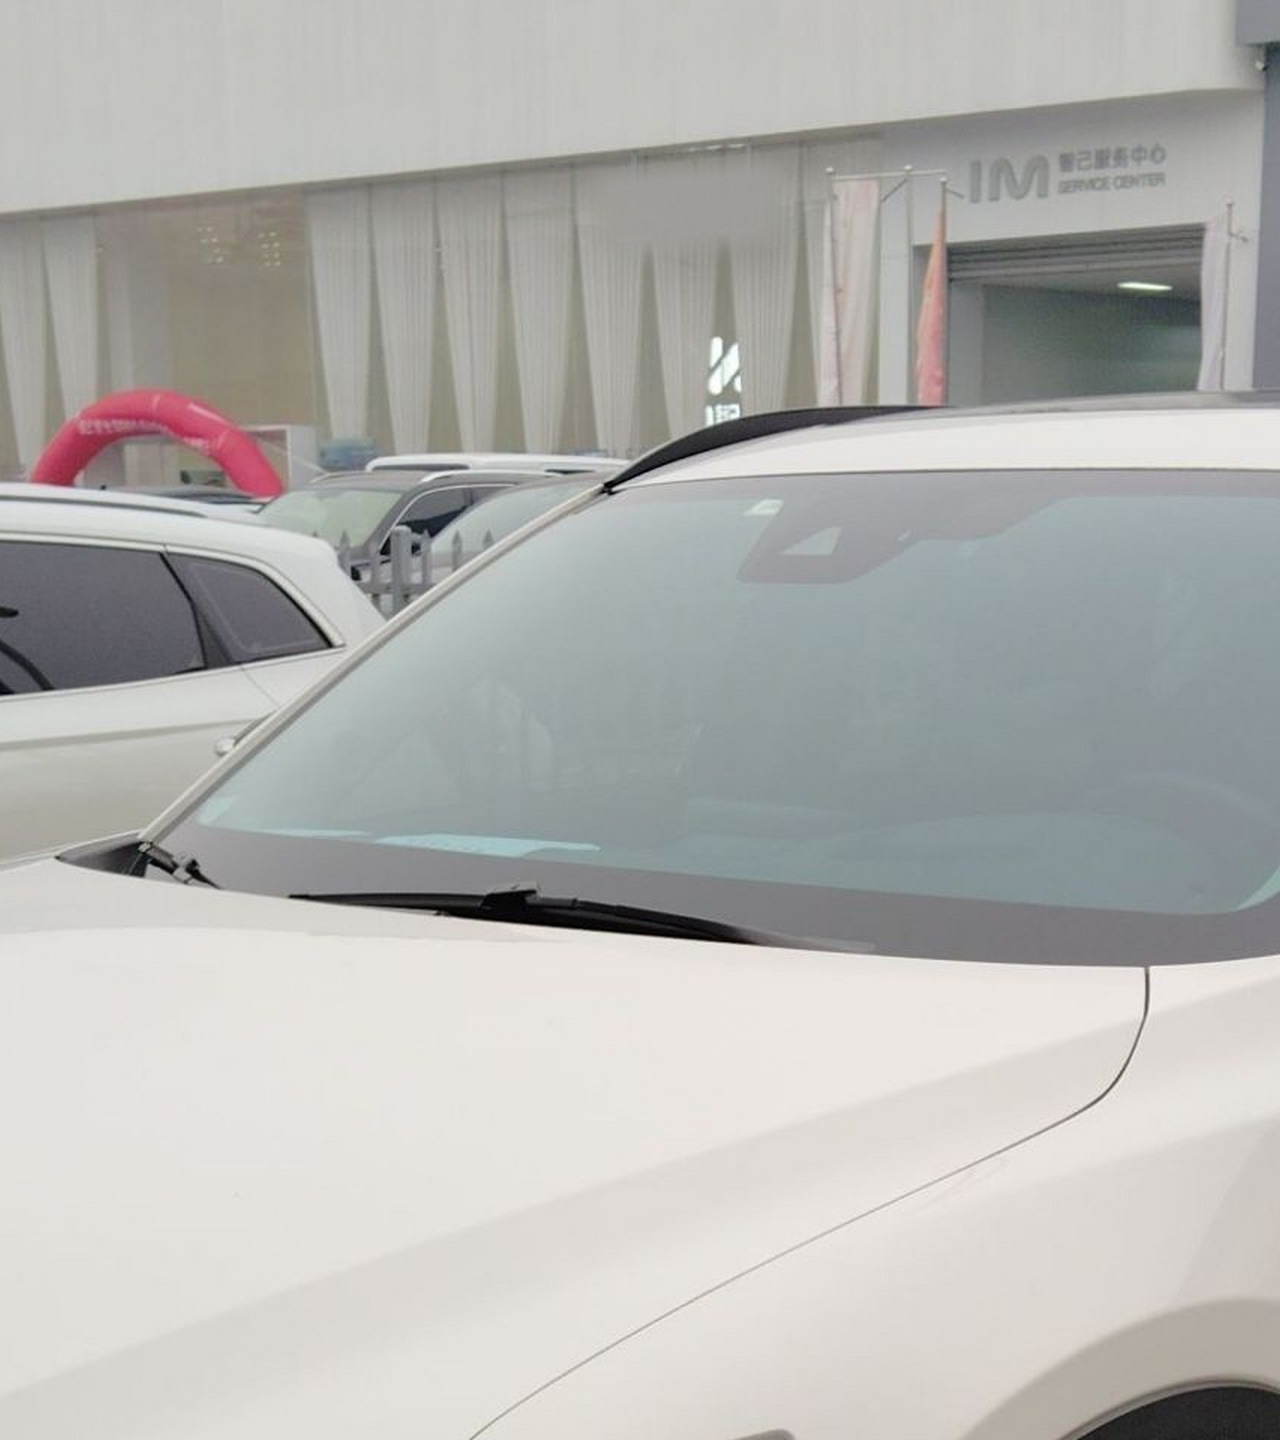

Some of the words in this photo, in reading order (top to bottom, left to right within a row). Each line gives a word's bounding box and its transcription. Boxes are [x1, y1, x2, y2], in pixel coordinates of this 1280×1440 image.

[969, 156, 1049, 203] IM
[1058, 178, 1112, 194] SERVICE
[1114, 172, 1165, 190] CENTER
